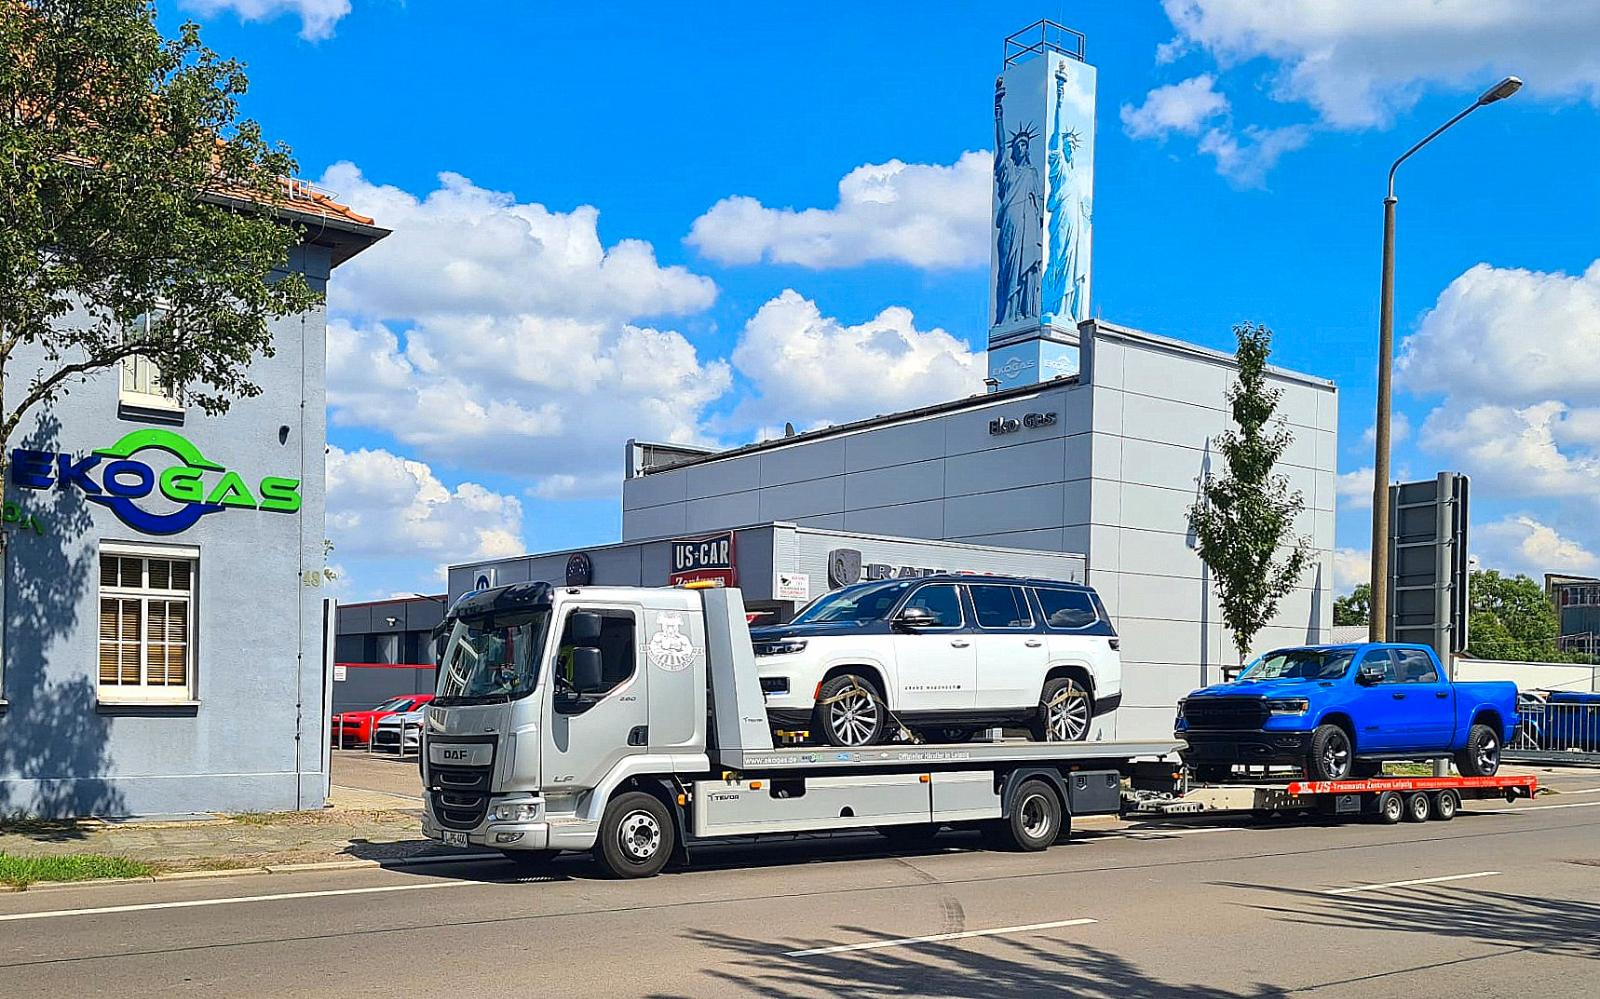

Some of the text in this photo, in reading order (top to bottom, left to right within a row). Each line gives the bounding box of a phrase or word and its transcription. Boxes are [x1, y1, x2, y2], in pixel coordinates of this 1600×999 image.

[990, 412, 1057, 435] Eko Gas
[12, 449, 302, 514] EKOGAS
[700, 540, 729, 565] CAR
[443, 750, 468, 760] DAF
[553, 775, 574, 783] LF
